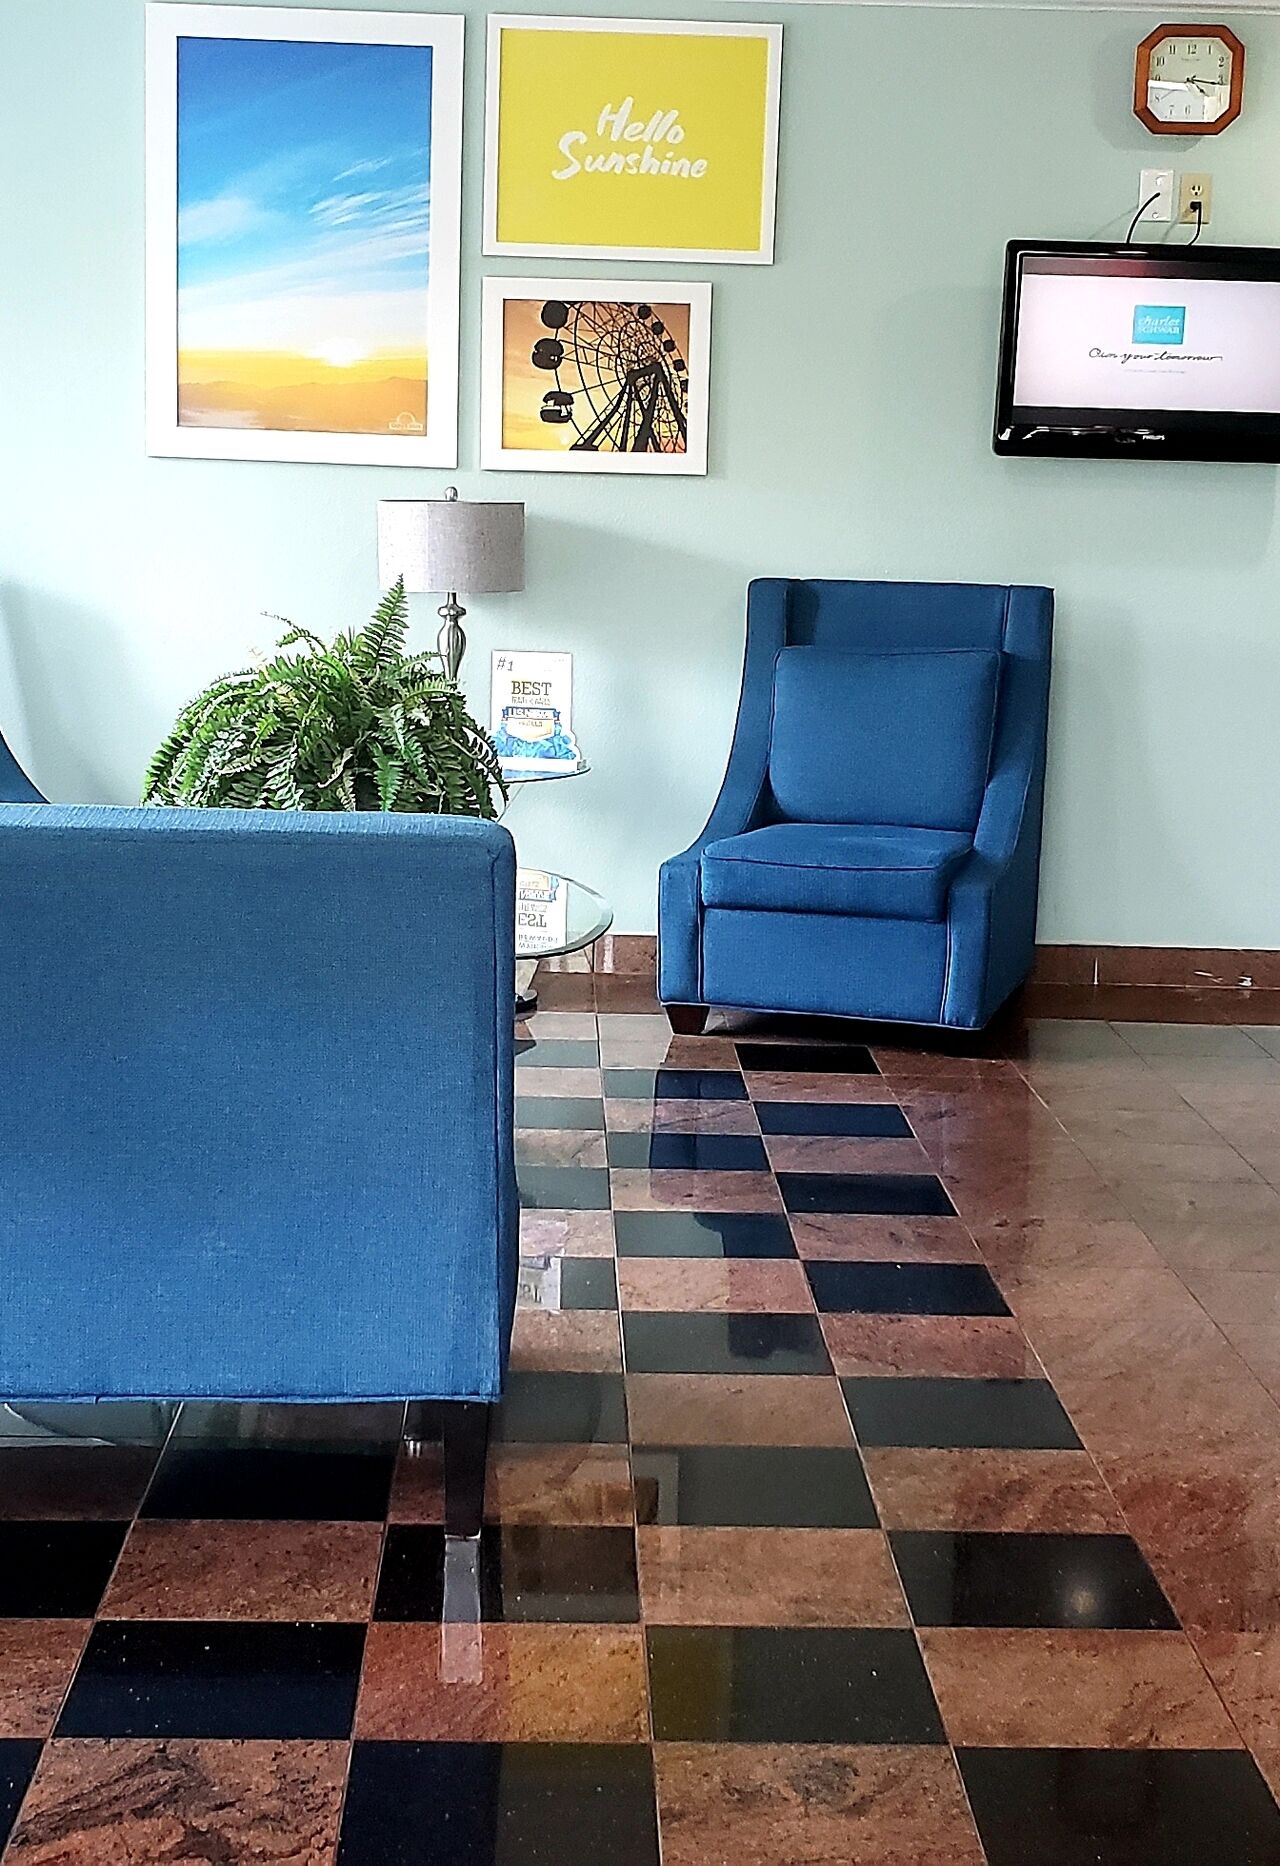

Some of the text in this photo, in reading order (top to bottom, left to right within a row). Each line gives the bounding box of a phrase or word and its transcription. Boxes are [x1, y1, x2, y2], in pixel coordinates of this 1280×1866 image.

[1187, 44, 1197, 55] 12
[1156, 56, 1225, 67] 10 2
[596, 96, 685, 144] Hello
[551, 130, 708, 180] Sunshine
[1088, 347, 1223, 364] Own your tomorrow
[496, 656, 514, 672] #1
[511, 680, 552, 696] BEST
